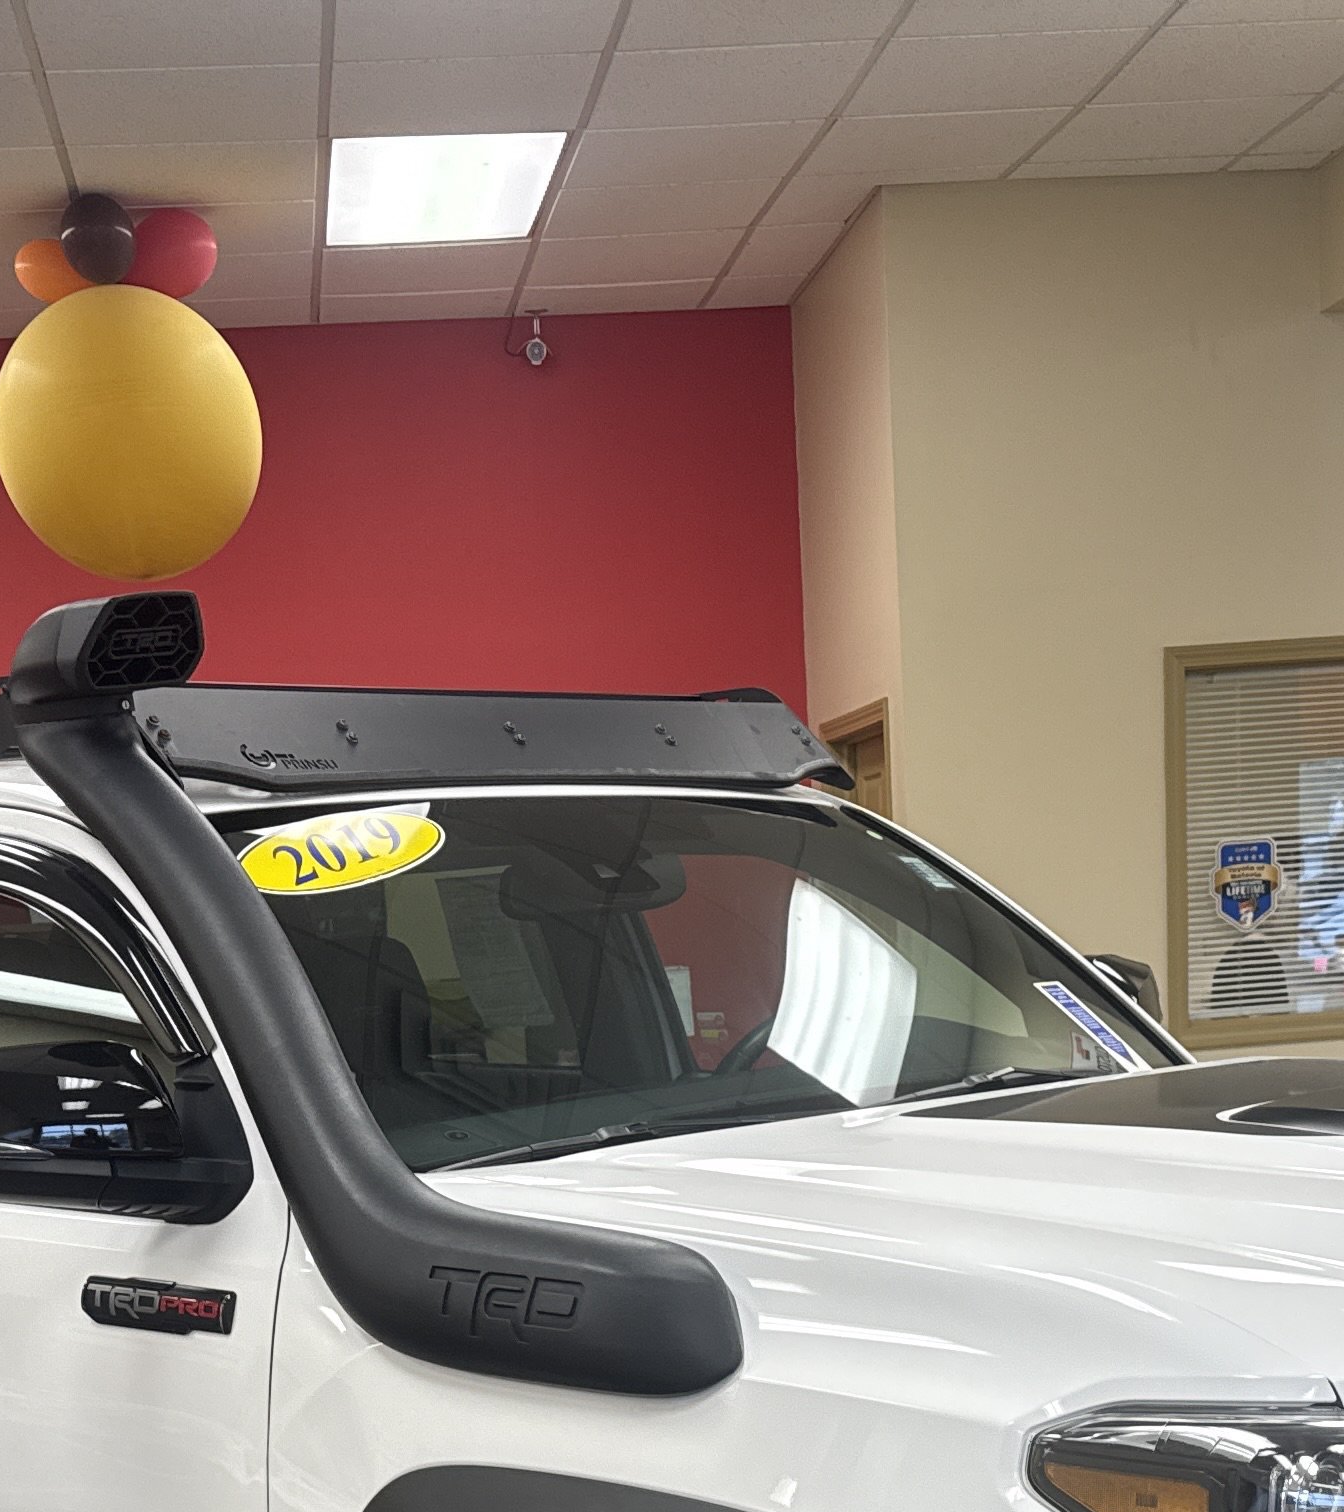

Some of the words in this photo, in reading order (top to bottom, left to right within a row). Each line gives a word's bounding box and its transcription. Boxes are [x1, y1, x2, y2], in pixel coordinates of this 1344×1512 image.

[272, 817, 402, 887] 2019
[86, 1283, 161, 1320] TRD
[160, 1295, 220, 1319] PRO
[429, 1265, 586, 1345] TRD
